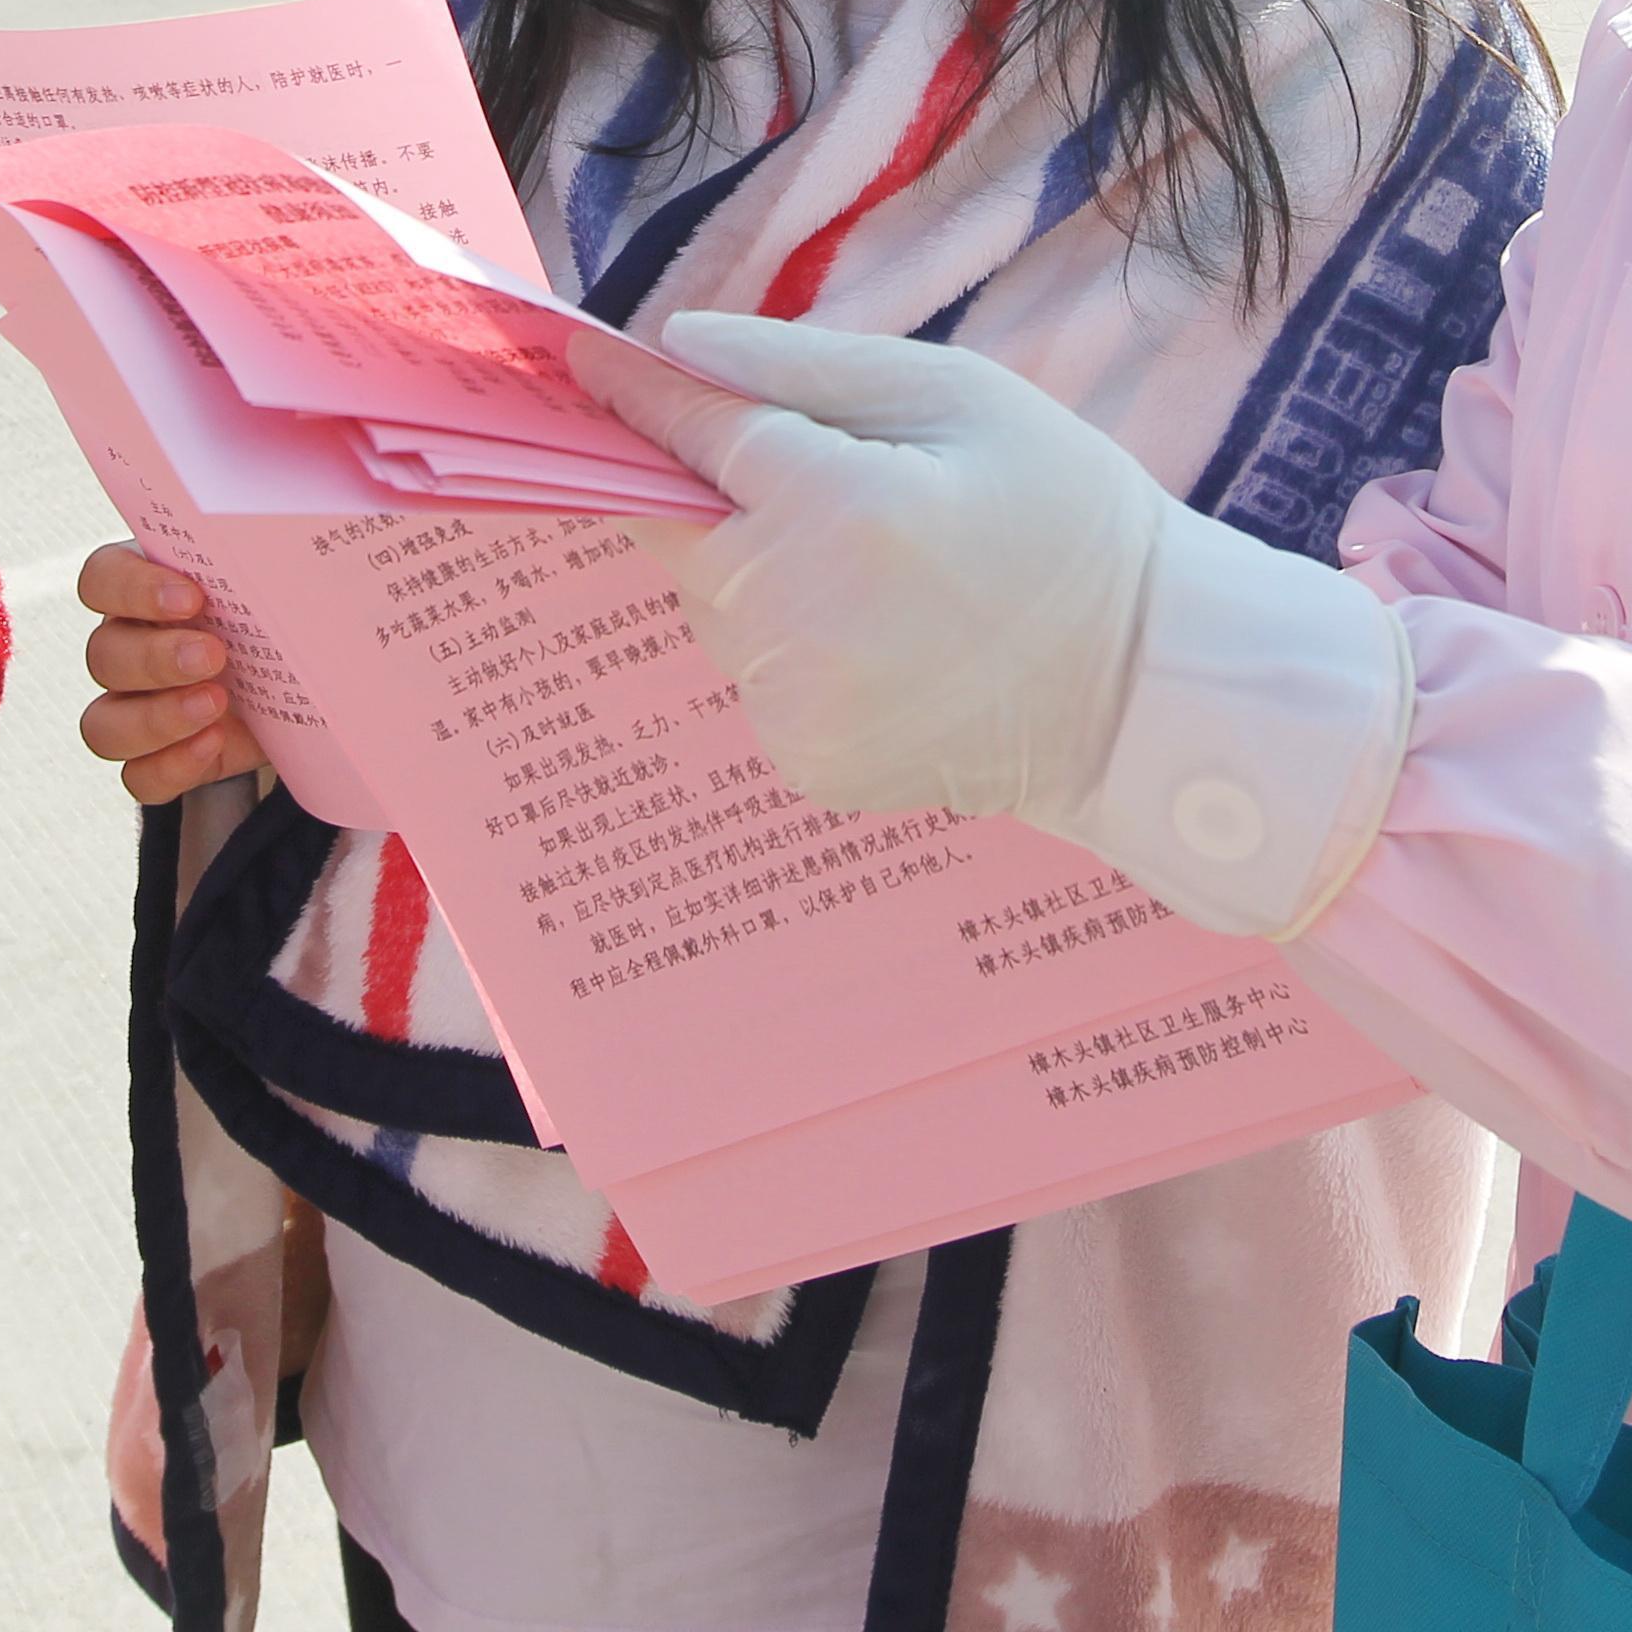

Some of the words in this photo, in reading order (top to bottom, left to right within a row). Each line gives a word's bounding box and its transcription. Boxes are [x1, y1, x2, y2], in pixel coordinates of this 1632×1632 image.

[419, 198, 459, 221] 接触
[539, 754, 776, 858] 如果出现上述症状，且有疫
[1028, 980, 1291, 1078] 樟木头镇社区卫生服务中心
[1045, 1014, 1310, 1111] 樟木头镇疾病预防控制中心
